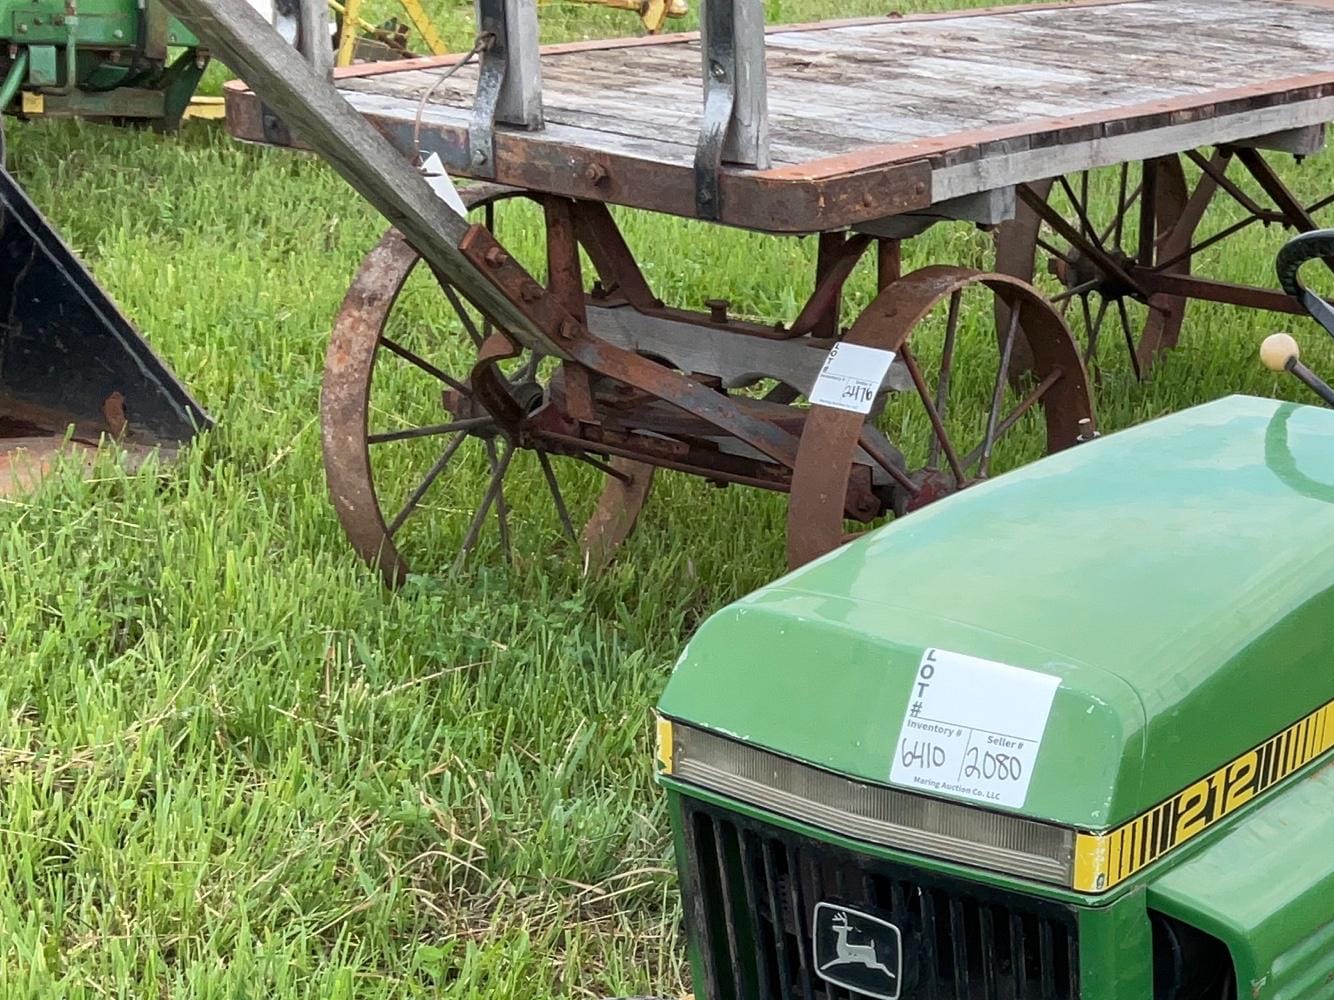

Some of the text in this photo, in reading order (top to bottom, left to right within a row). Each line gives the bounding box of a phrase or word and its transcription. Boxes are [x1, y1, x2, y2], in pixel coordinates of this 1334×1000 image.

[907, 718, 963, 738] Inventory #
[901, 738, 946, 768] 6410
[987, 735, 1025, 750] Seller #
[964, 746, 1022, 781] 2080
[913, 775, 1001, 801] Maring Auction Co. LLC
[1175, 751, 1258, 845] 212
